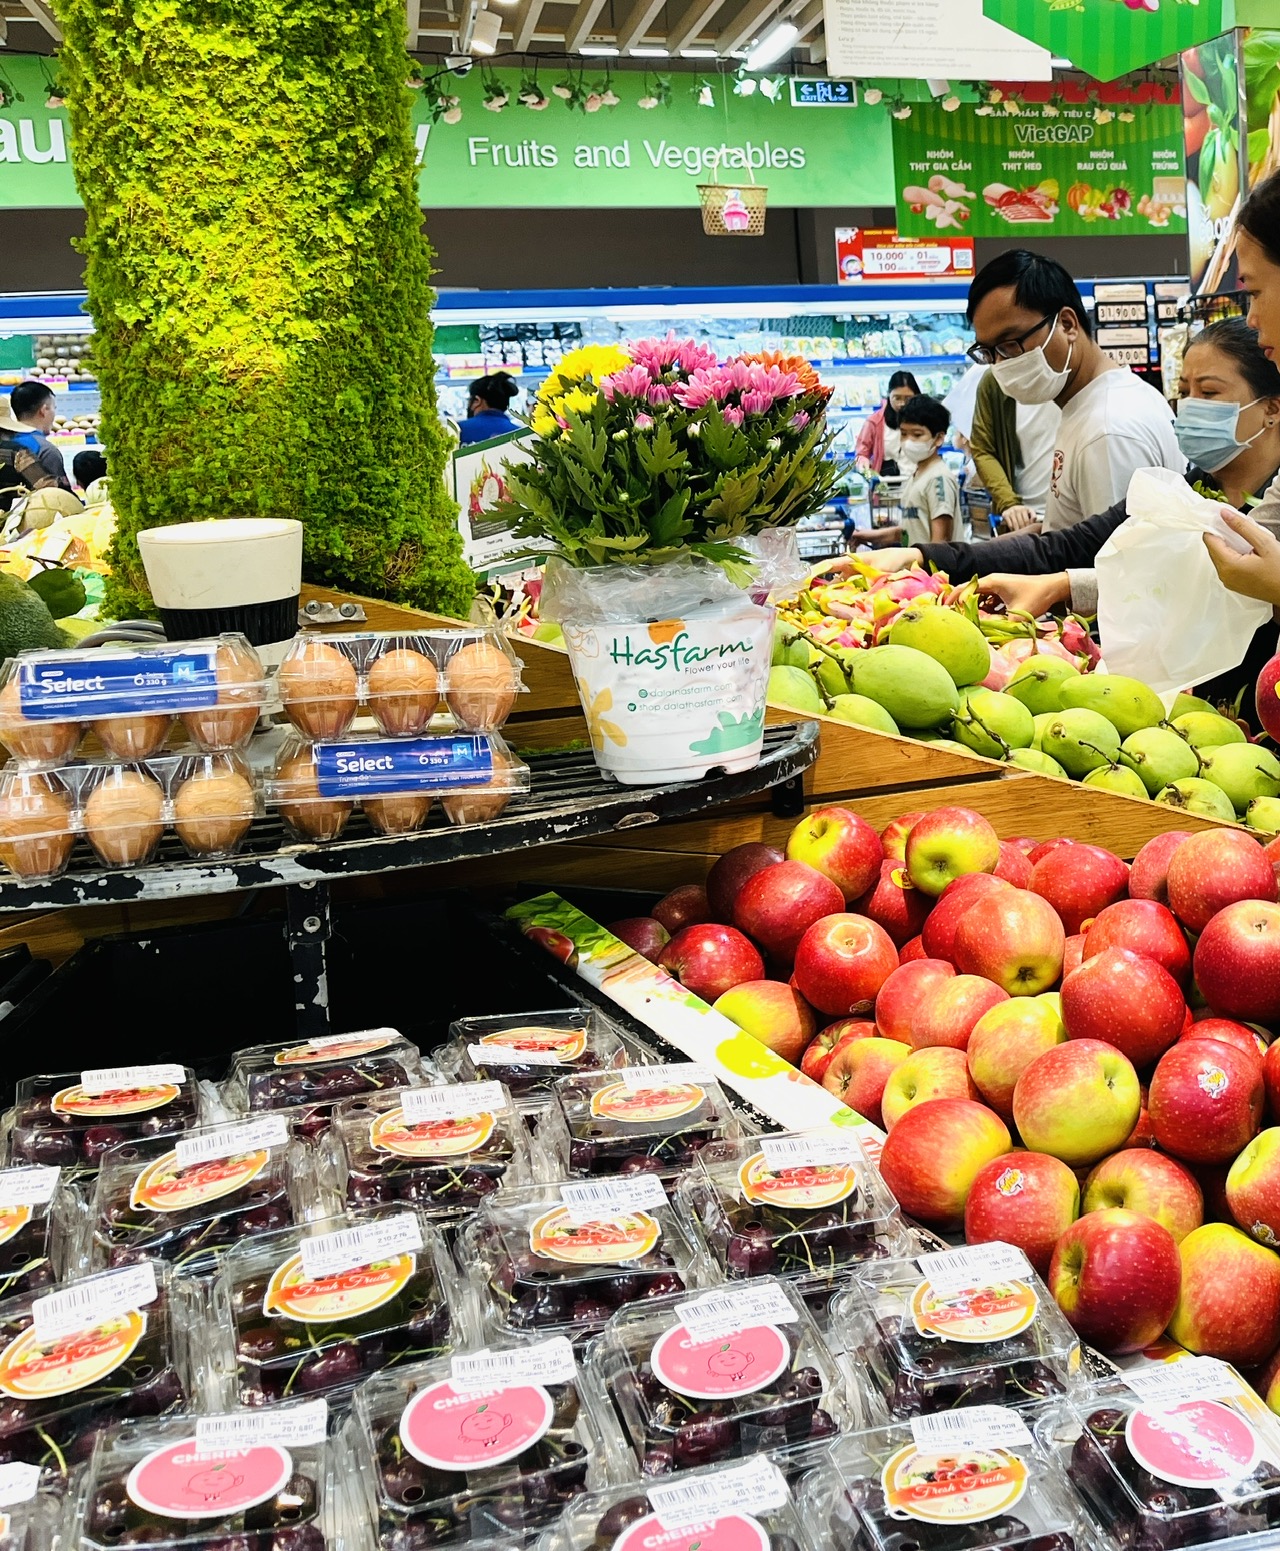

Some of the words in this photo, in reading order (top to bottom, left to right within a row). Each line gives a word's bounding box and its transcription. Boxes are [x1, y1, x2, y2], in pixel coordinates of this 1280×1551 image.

[1014, 124, 1094, 143] VietGAP
[467, 136, 559, 167] Fruits
[574, 140, 631, 169] and
[643, 139, 806, 176] Vegetables
[926, 150, 954, 159] NHÓM
[1008, 150, 1035, 159] NHÓM
[1090, 150, 1114, 159] NHÓM
[1153, 150, 1176, 159] NHÓM
[909, 162, 931, 172] THỊT
[933, 162, 949, 171] GIA
[951, 160, 972, 171] CẦM
[1002, 162, 1022, 172] THỊT
[1024, 162, 1042, 171] HEO
[1077, 162, 1094, 171] RAU
[610, 632, 753, 672] Hasfarm
[178, 667, 190, 677] M
[685, 663, 715, 676] Flower
[716, 660, 737, 673] your
[738, 656, 750, 665] life
[40, 676, 105, 694] Select
[133, 673, 145, 686] 6
[419, 754, 429, 765] 6
[456, 747, 468, 756] M
[336, 755, 394, 774] Select
[292, 1282, 339, 1298] Fresh
[343, 1272, 391, 1289] Fruits
[20, 1357, 69, 1376] Fresh
[72, 1337, 120, 1361] Fruits
[433, 1387, 506, 1411] CHERRY
[171, 1448, 252, 1465] CHERRY
[912, 1483, 957, 1500] Fresh
[959, 1472, 1007, 1491] Fruits
[642, 1519, 718, 1548] CHERRY
